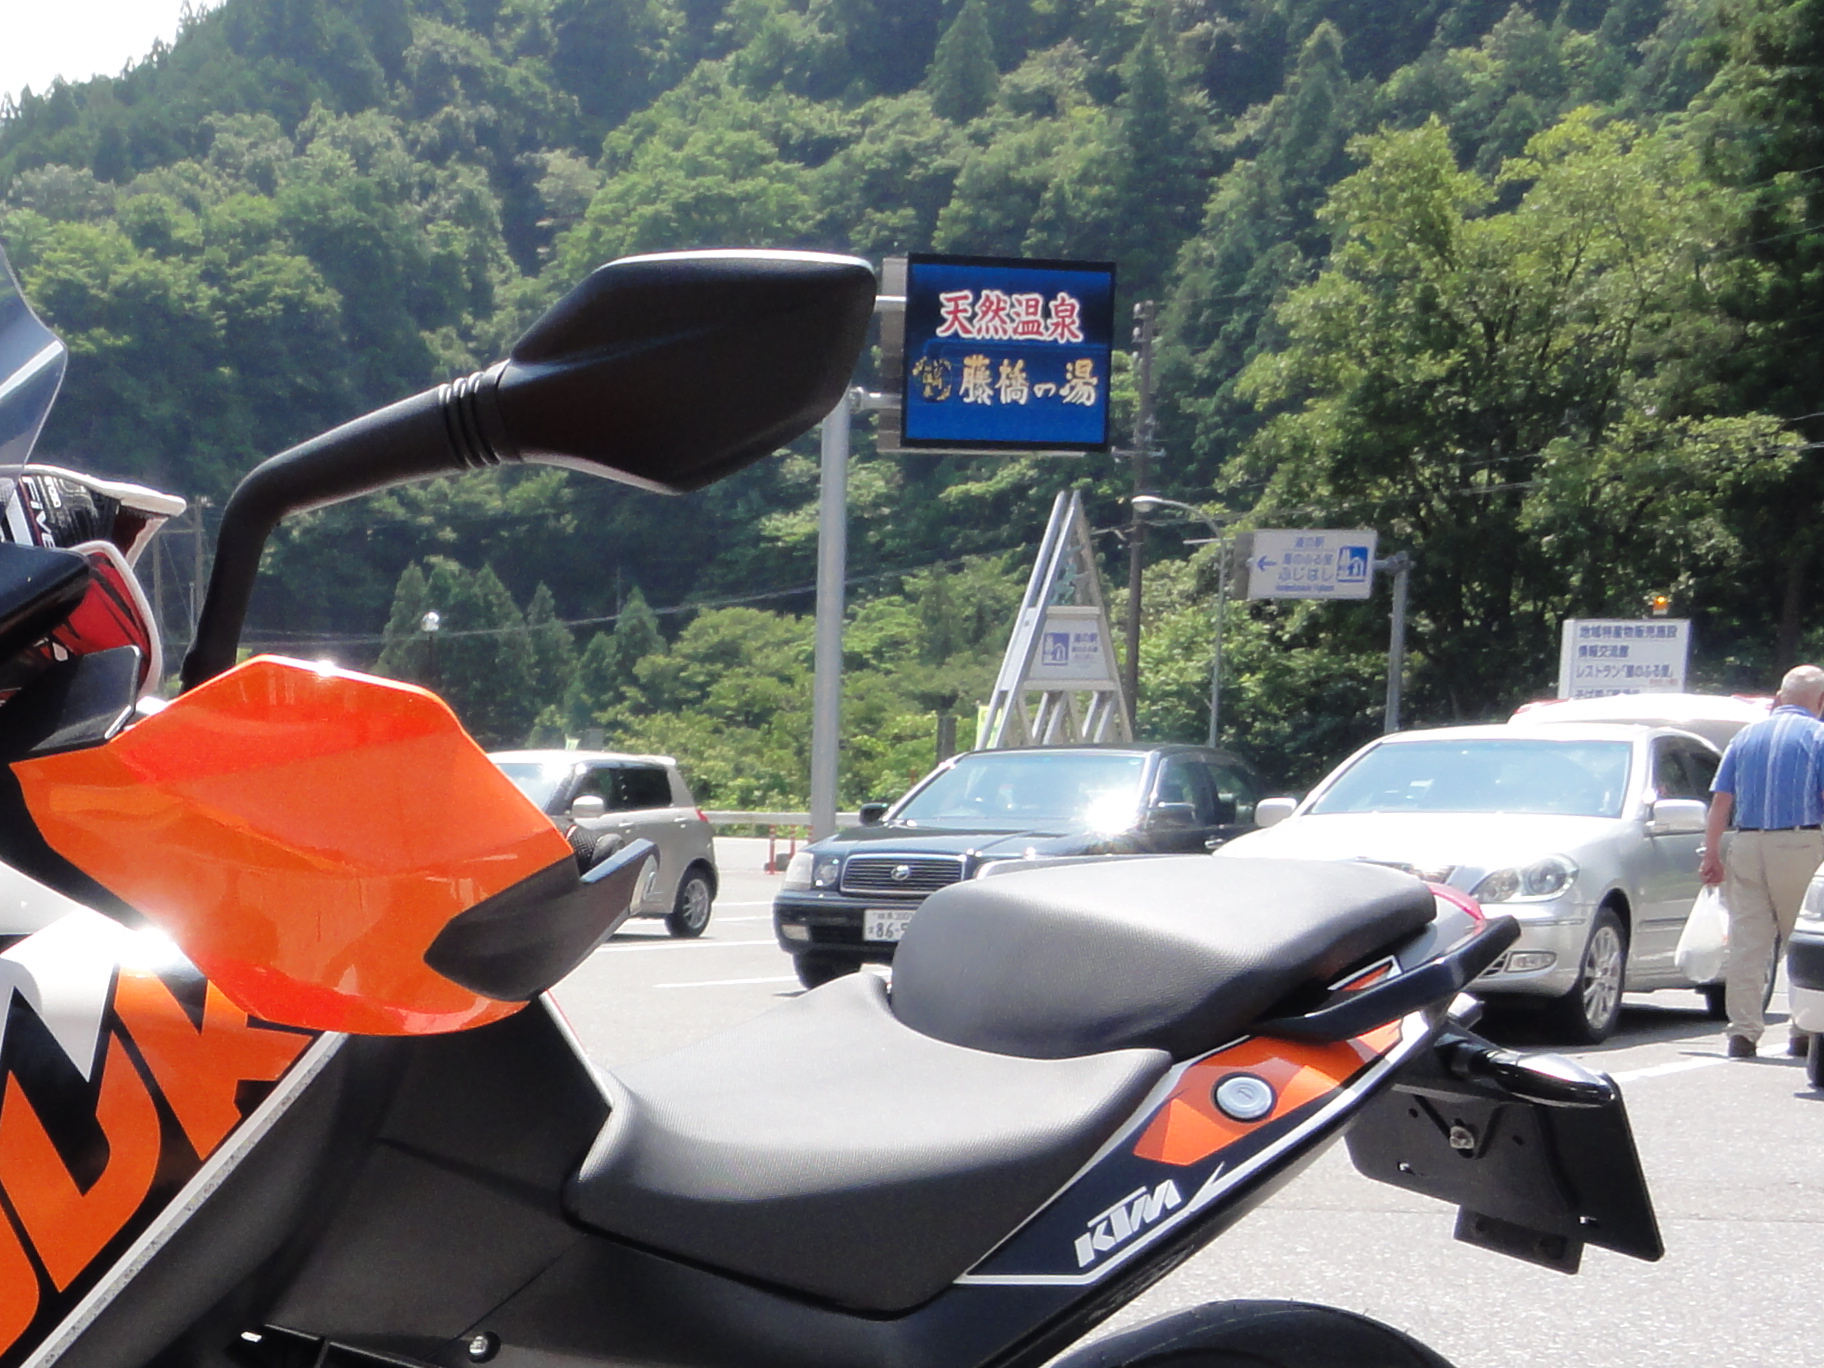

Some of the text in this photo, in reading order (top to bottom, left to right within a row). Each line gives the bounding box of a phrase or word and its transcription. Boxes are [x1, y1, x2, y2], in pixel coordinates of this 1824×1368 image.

[936, 289, 1083, 343] 天然温泉
[959, 354, 1098, 405] 藤橋の湯
[1074, 1179, 1182, 1268] KTM
